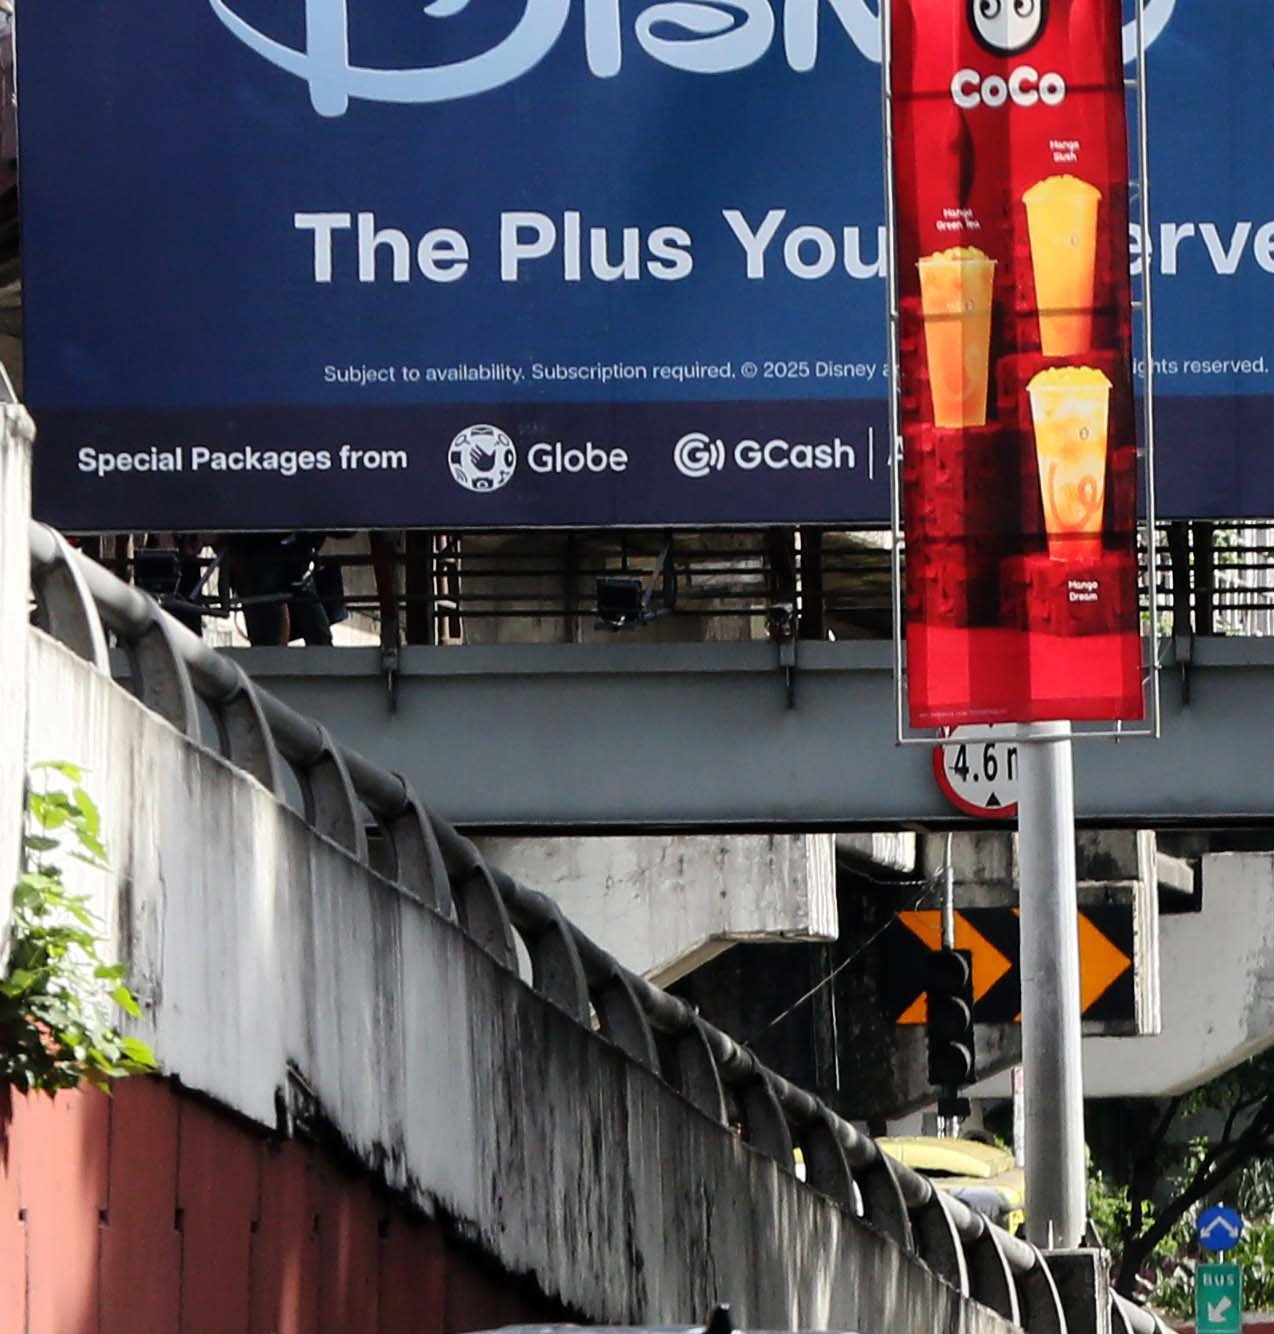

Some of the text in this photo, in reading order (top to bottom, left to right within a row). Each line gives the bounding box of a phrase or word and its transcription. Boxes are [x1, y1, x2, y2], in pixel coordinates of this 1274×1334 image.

[295, 212, 471, 283] The
[501, 211, 695, 282] Plus
[723, 210, 888, 279] You
[324, 364, 396, 387] Subject
[403, 366, 421, 382] to
[426, 363, 526, 384] availability.
[532, 361, 647, 383] Subscription
[653, 361, 736, 381] required.
[764, 362, 810, 378] 2025
[816, 361, 876, 382] Disney
[1133, 356, 1270, 379] ights reserved.
[79, 445, 408, 475] Special Packages from
[528, 442, 629, 473] Globe
[734, 437, 856, 469] GCash
[1068, 579, 1098, 591] Mango
[953, 743, 998, 783] 4.6
[1203, 1272, 1235, 1288] BUS
